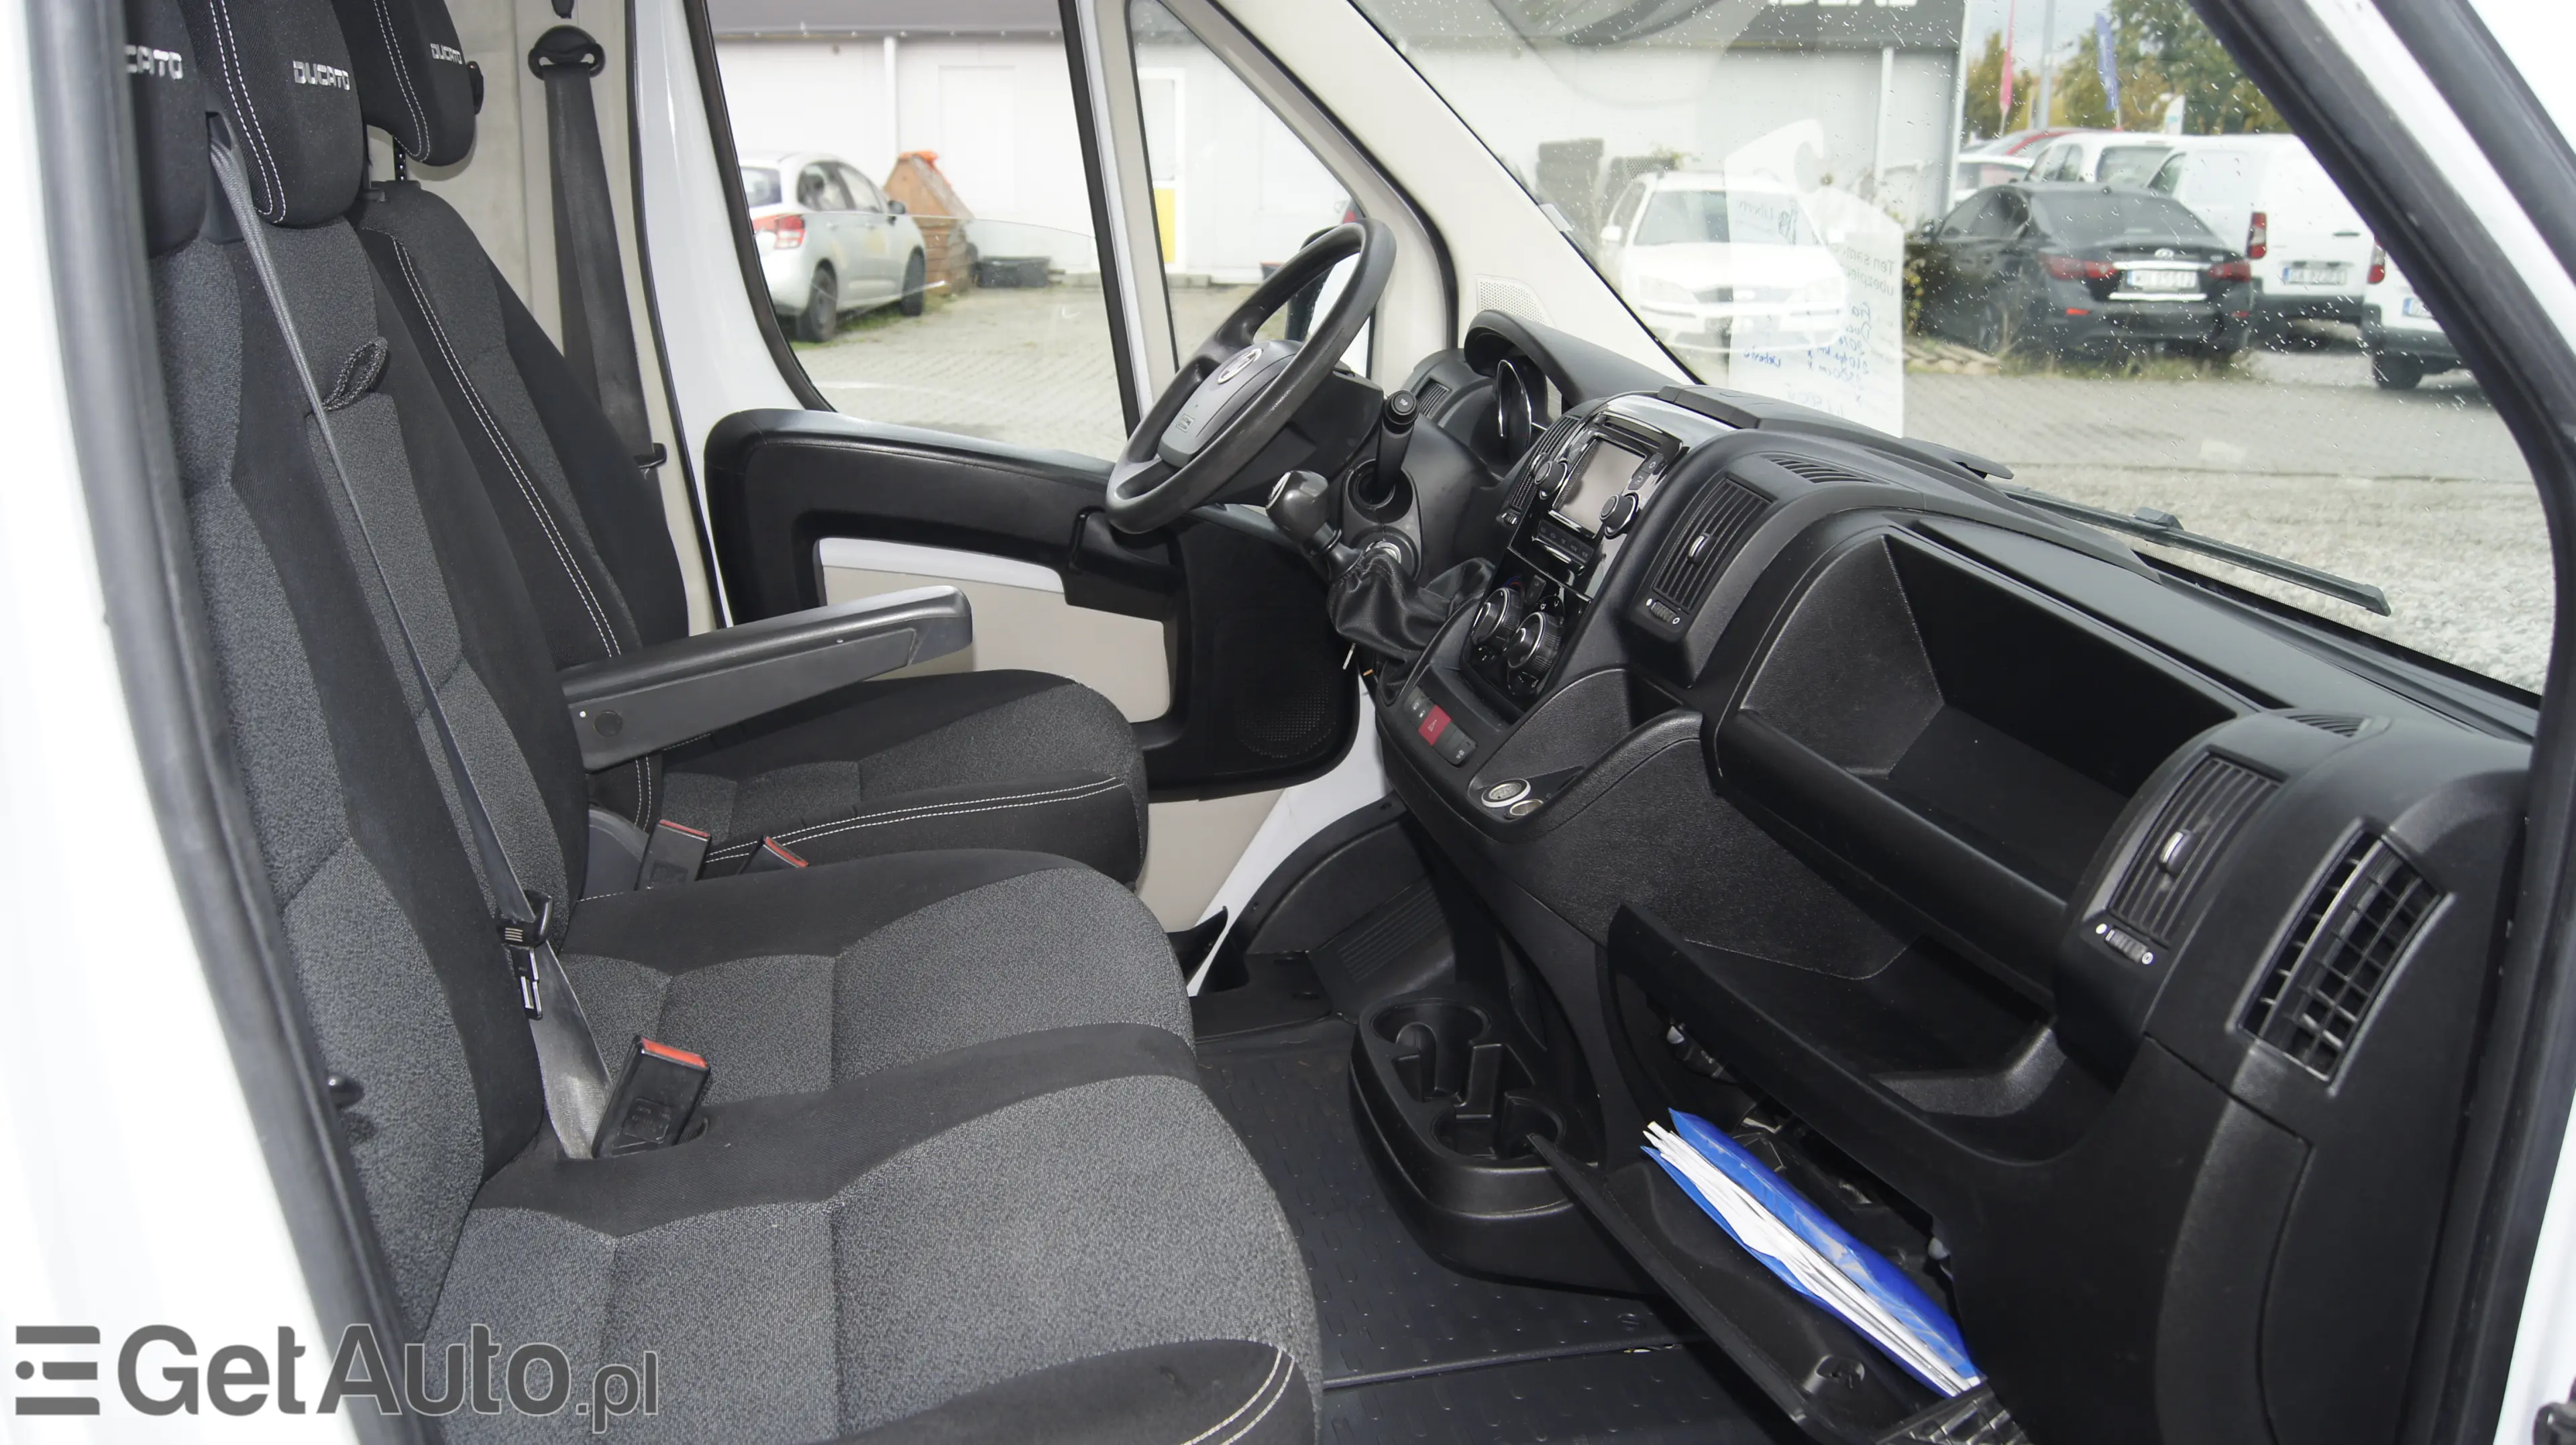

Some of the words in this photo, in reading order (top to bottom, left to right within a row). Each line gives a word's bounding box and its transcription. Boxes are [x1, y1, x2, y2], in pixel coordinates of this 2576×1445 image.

[124, 45, 183, 80] CATO
[430, 43, 463, 65] DUCATO
[292, 60, 350, 91] DUCATO
